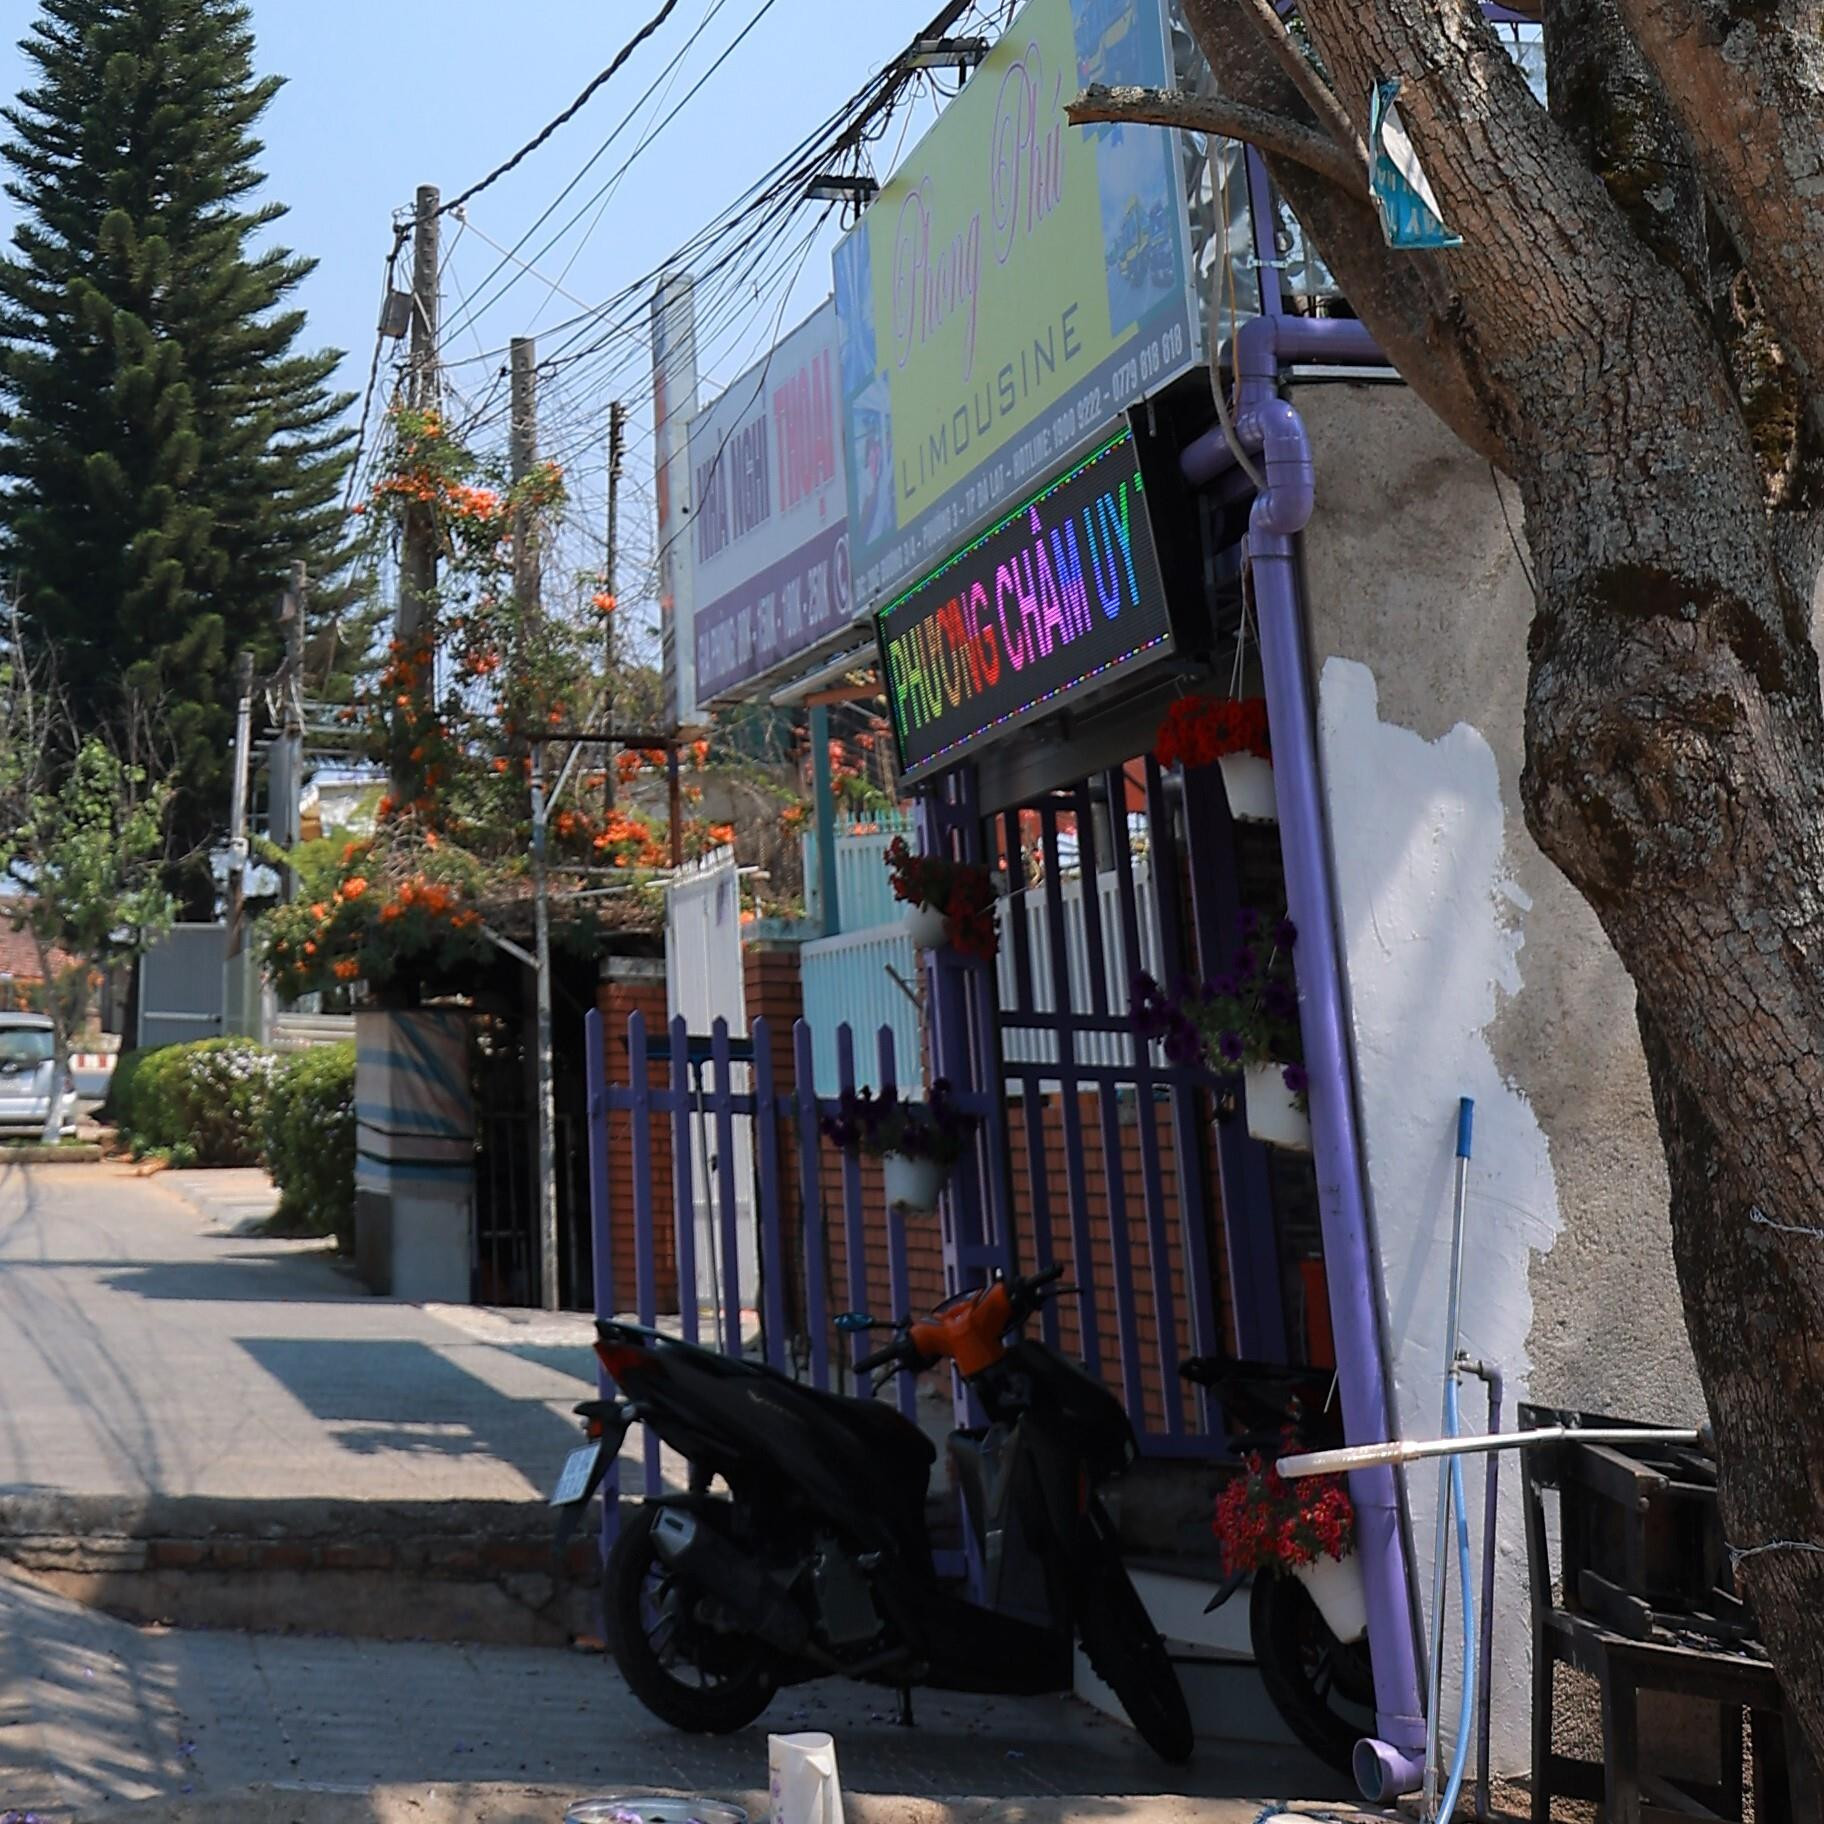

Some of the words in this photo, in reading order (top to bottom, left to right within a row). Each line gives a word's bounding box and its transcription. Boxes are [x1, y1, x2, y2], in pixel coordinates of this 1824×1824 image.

[893, 174, 981, 385] Phong
[991, 39, 1064, 264] Phú
[773, 348, 836, 519] THOẠI
[902, 302, 1082, 499] LIMOUSINE
[1111, 357, 1138, 402] 0779
[1082, 480, 1142, 622] UY
